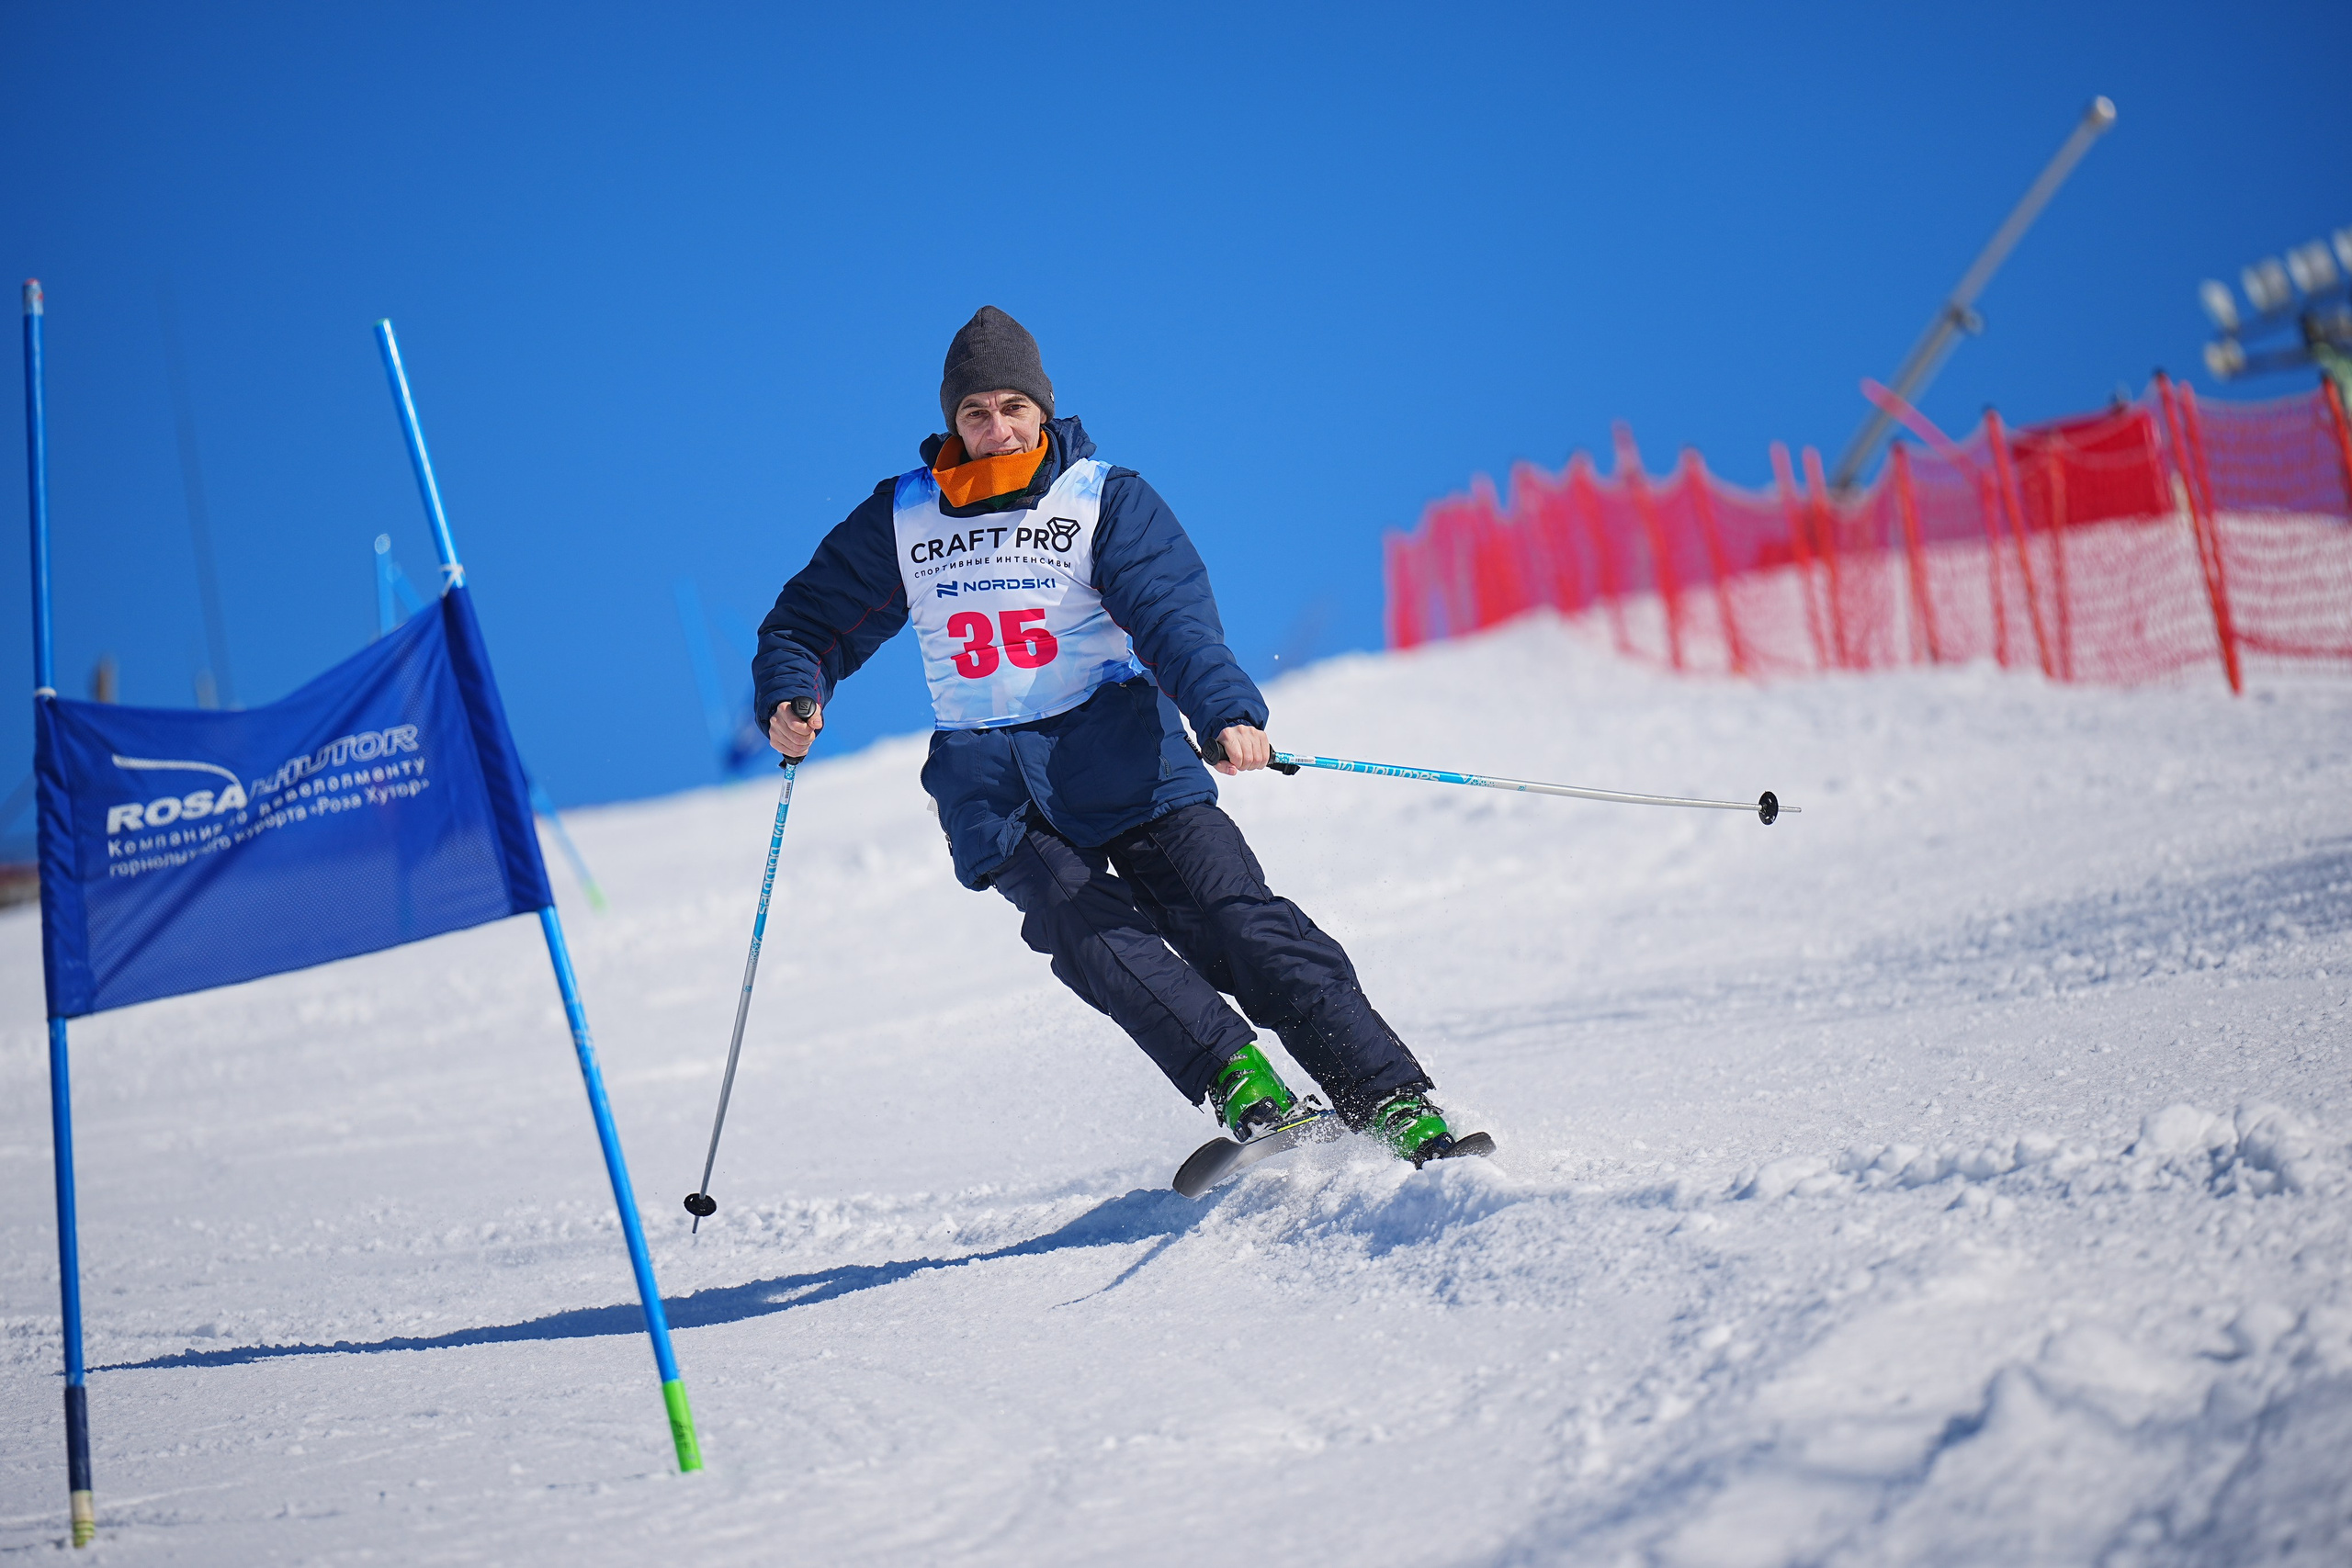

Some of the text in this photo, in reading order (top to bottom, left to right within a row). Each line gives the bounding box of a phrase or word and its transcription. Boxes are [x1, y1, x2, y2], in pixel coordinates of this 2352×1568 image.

[910, 518, 1079, 564] CRAFT PRO
[914, 555, 1071, 579] СПОРТИВНЫЕ ИНТЕНСИВЫ
[963, 578, 1057, 592] NORDSKI
[946, 608, 1058, 680] 35
[107, 784, 248, 835] ROSA
